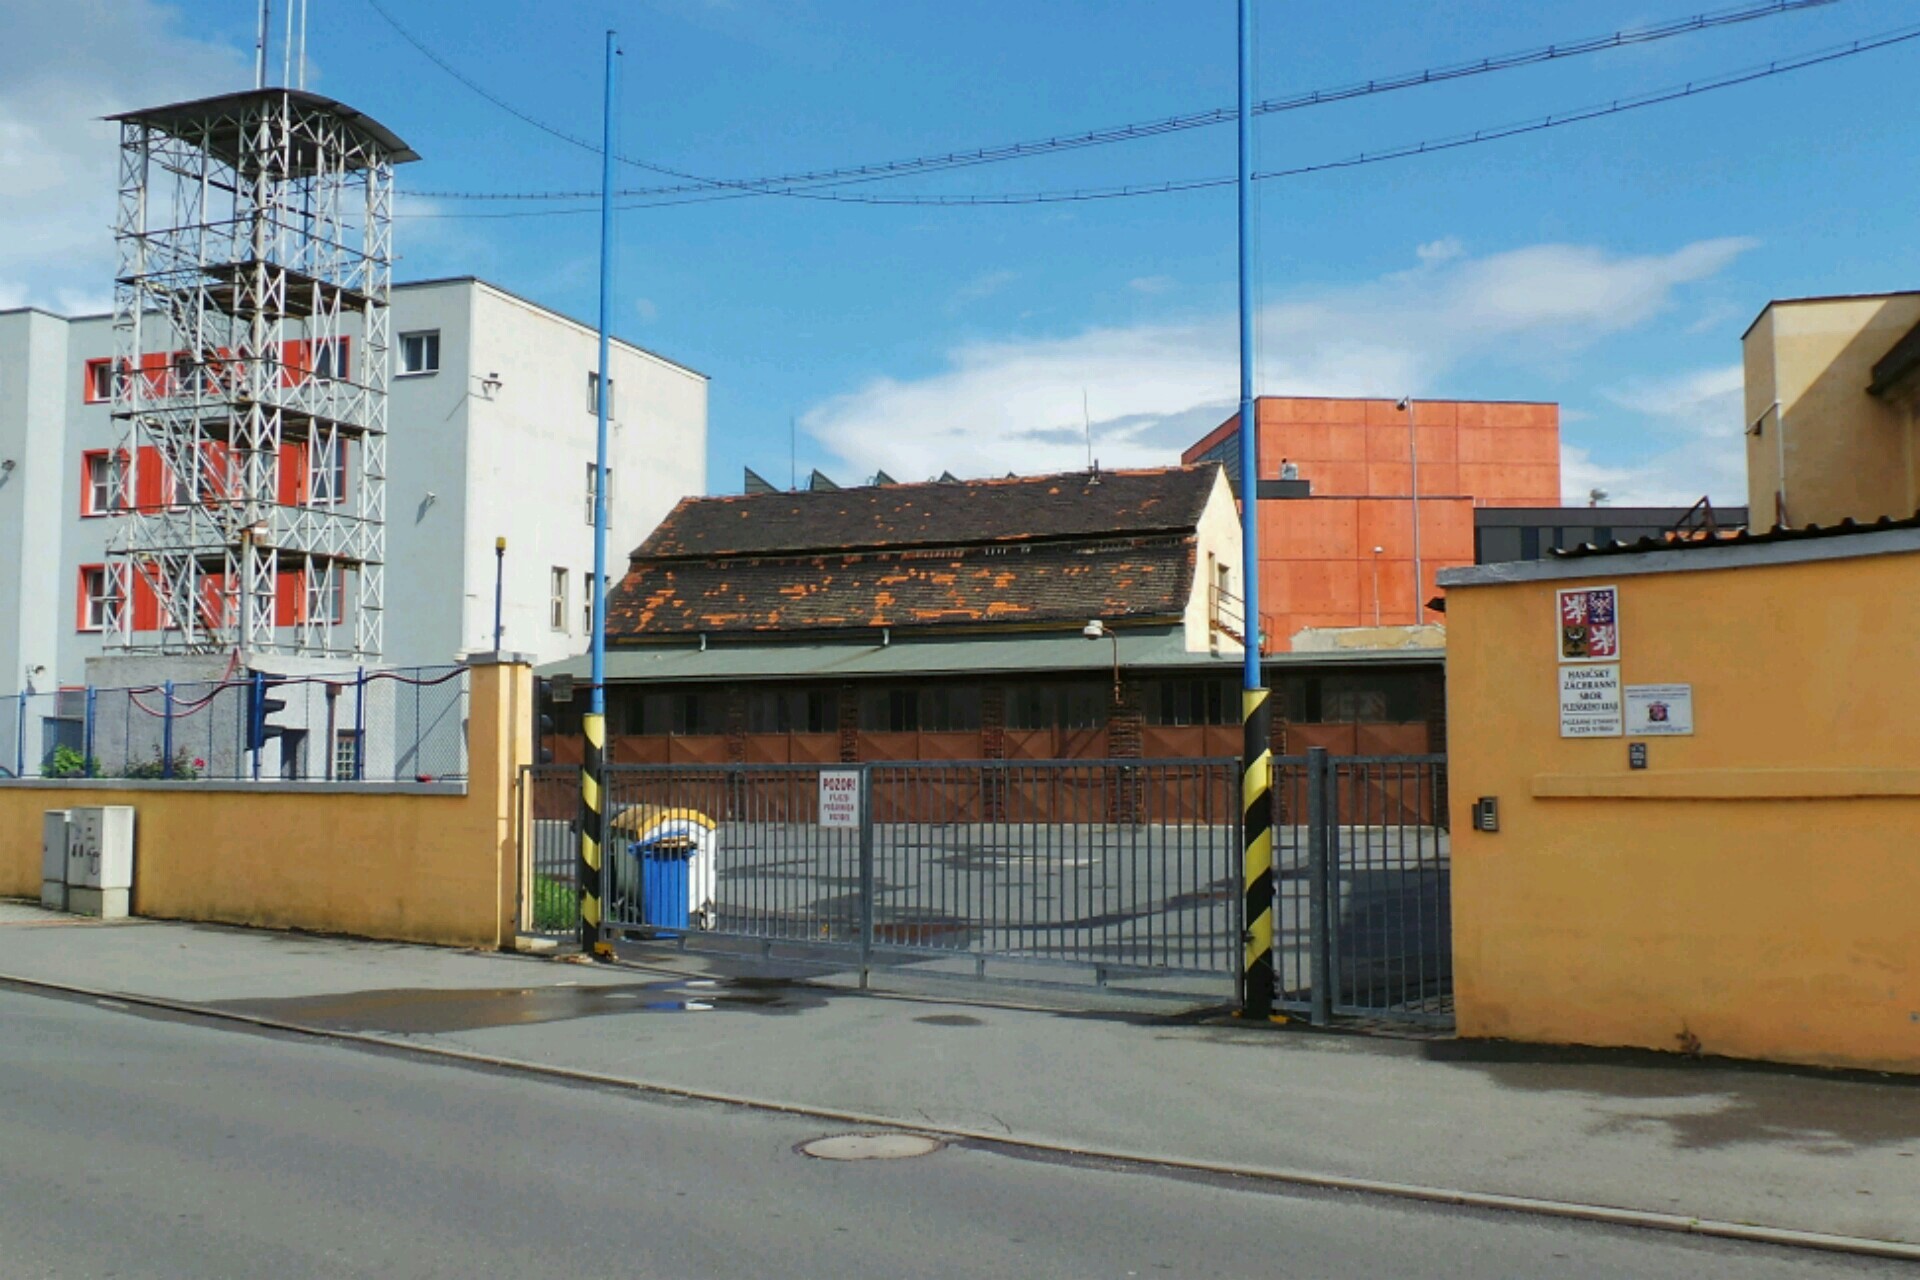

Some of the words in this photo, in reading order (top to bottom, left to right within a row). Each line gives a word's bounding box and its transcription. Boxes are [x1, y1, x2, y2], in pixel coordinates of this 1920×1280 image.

[1564, 678, 1617, 690] ZÁCHRANNÝ
[1579, 691, 1602, 700] SBOR
[823, 777, 856, 791] POZOR!
